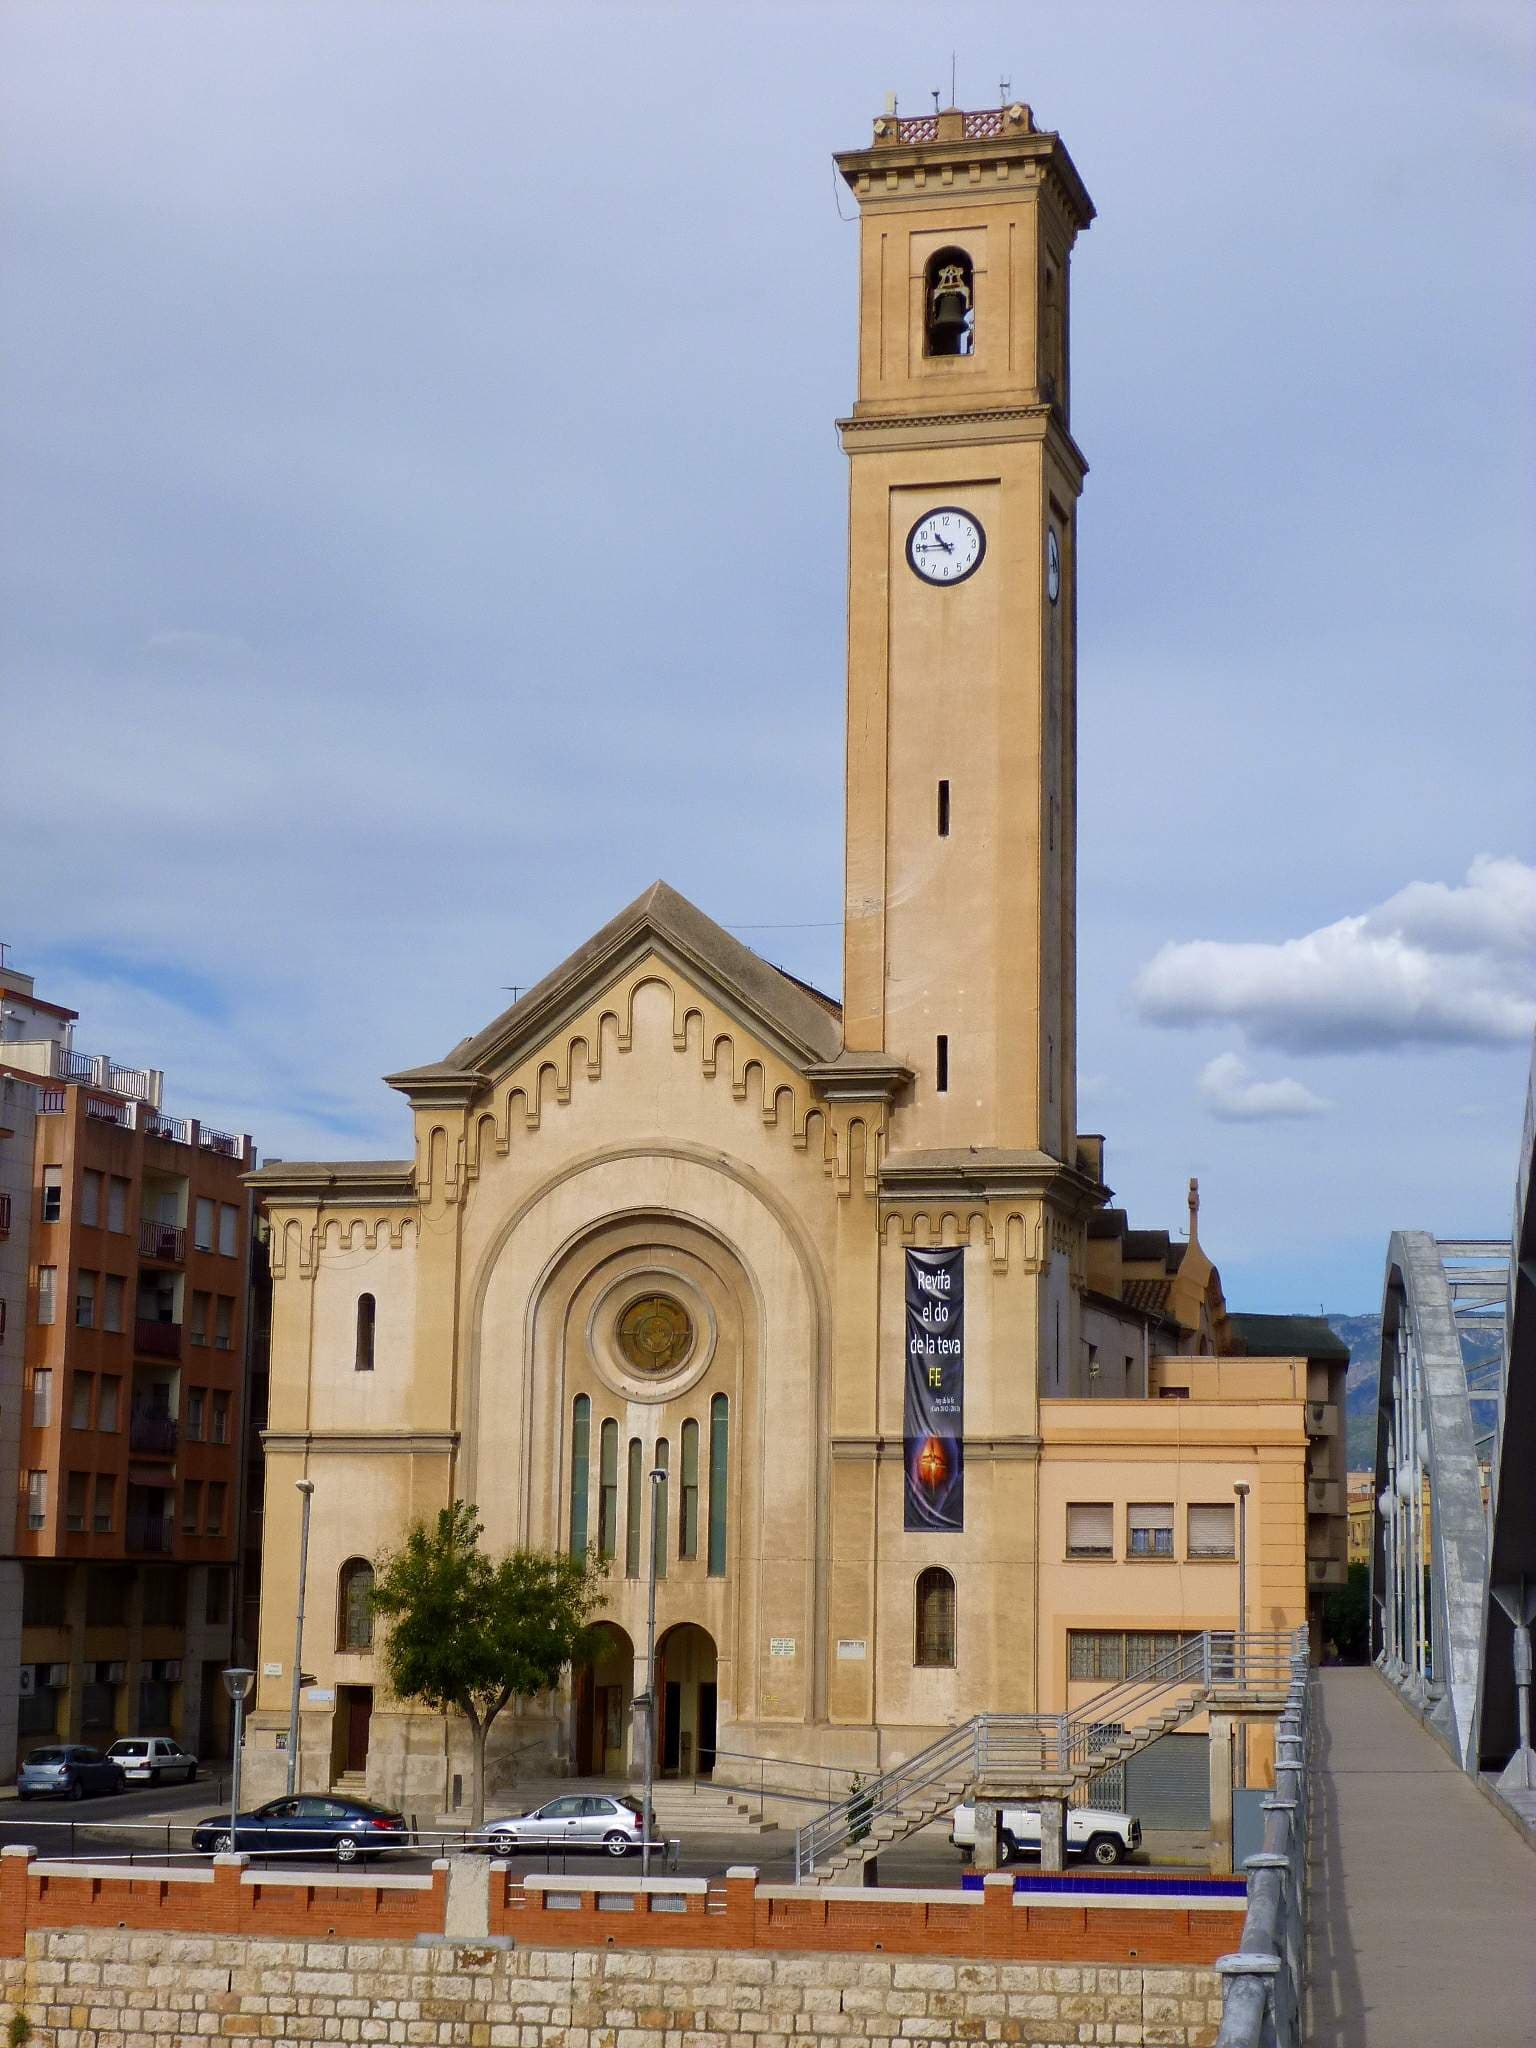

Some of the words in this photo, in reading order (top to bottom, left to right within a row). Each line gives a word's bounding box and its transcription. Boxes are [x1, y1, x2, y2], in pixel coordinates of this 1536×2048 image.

[929, 520, 936, 531] 11
[942, 516, 950, 526] 12
[920, 530, 928, 540] 10
[917, 1269, 951, 1290] Revifa
[922, 1301, 932, 1322] el
[934, 1301, 949, 1322] do
[910, 1333, 924, 1354] de
[926, 1333, 935, 1354] la
[937, 1335, 961, 1354] teva
[928, 1367, 942, 1387] FE
